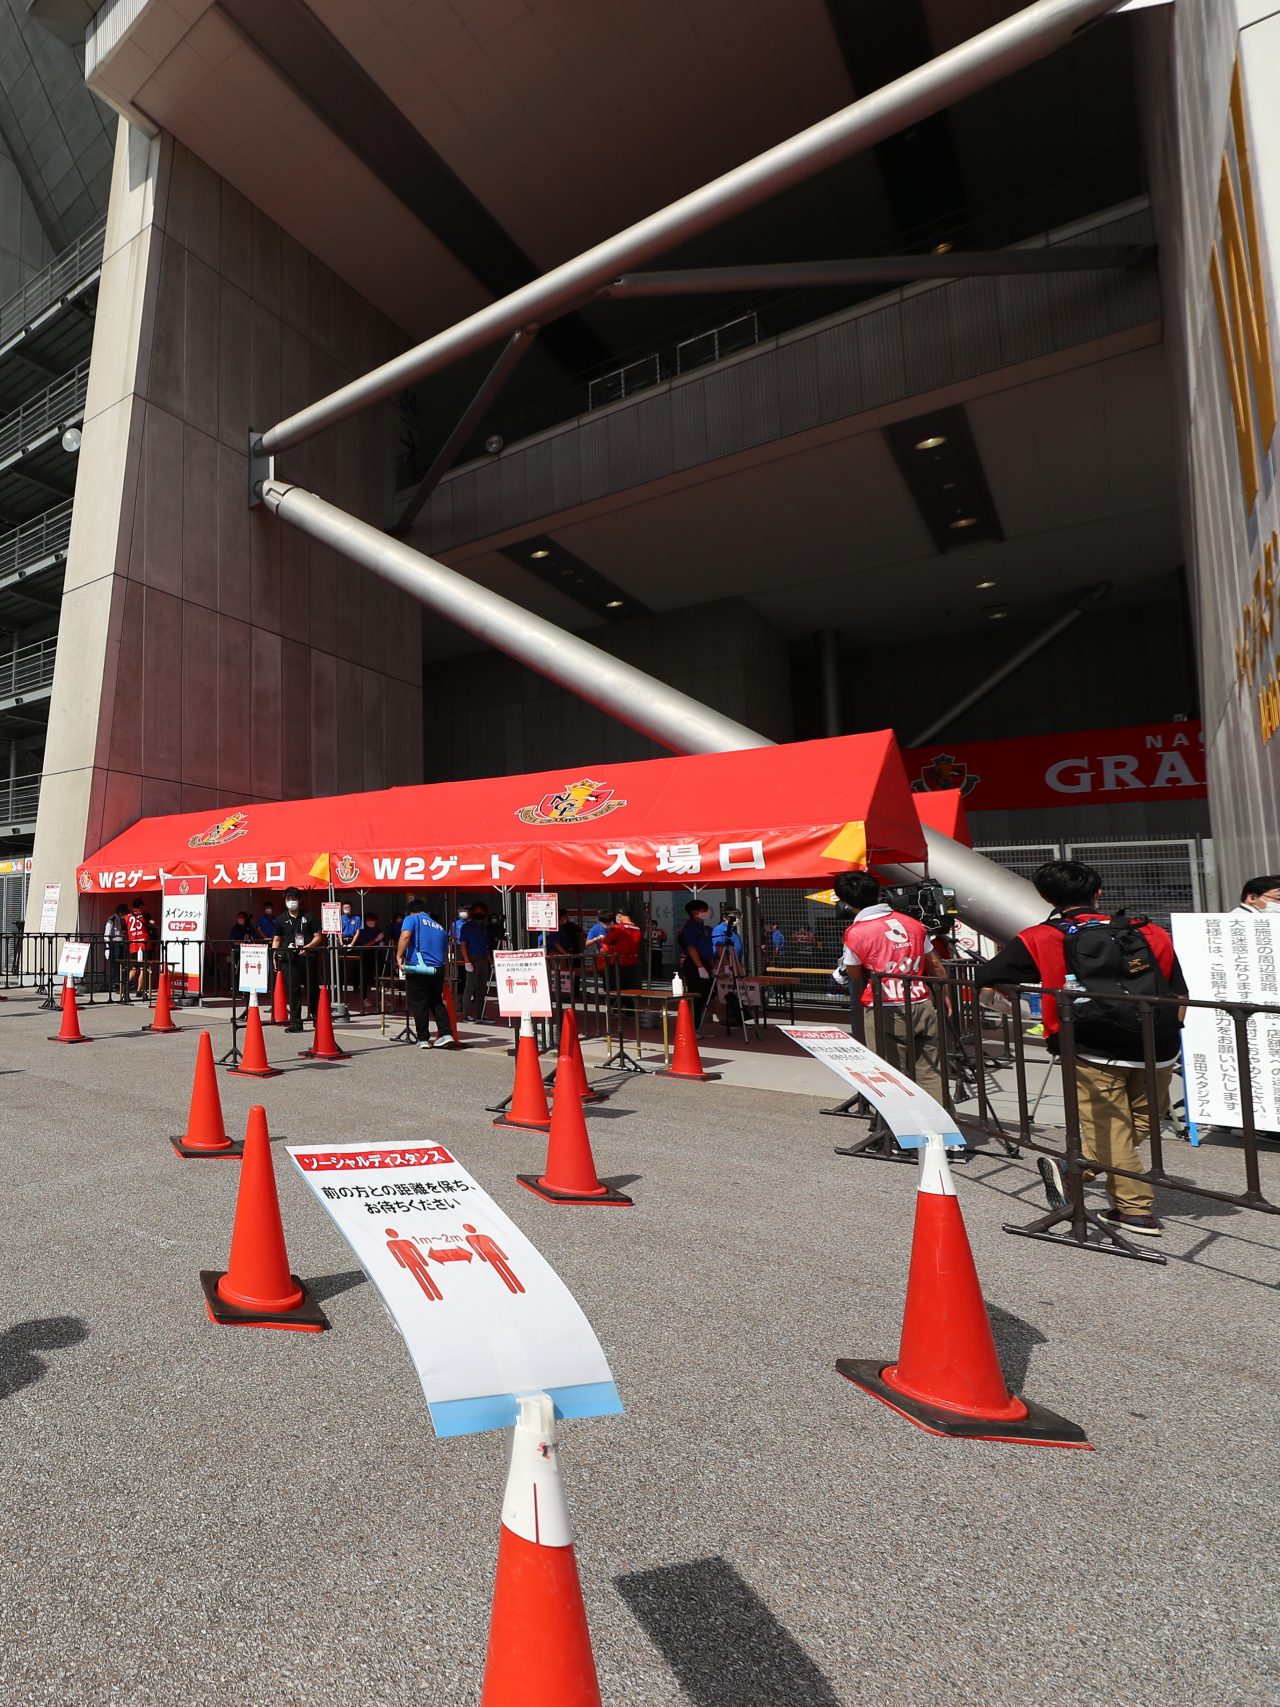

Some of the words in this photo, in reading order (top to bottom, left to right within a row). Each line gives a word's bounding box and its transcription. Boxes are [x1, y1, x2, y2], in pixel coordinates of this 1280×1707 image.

[1044, 750, 1207, 794] GRA
[372, 853, 516, 881] W2ゲート
[601, 839, 766, 878] 入場口
[98, 867, 173, 889] W2ゲート
[211, 860, 286, 885] 入場口
[169, 922, 196, 931] W2ゲート
[1193, 1053, 1212, 1118] 豊田スタジアム
[304, 1150, 447, 1169] ソーシャルディスタンス
[321, 1179, 477, 1199] 前の方との距離を保ち、
[363, 1198, 462, 1215] お待ちください
